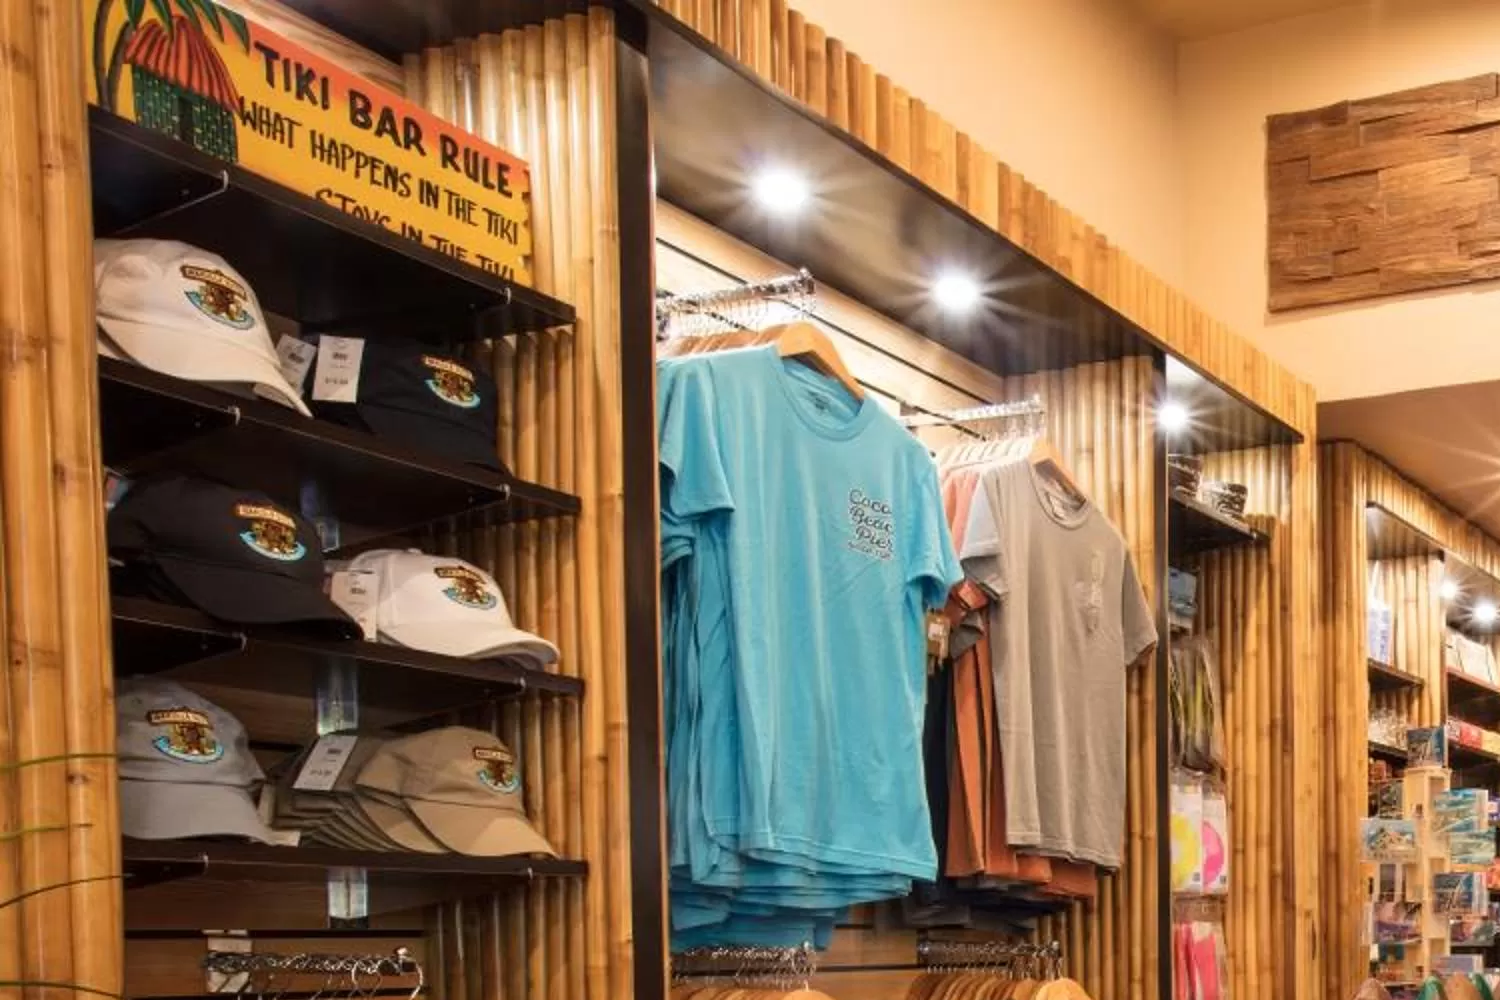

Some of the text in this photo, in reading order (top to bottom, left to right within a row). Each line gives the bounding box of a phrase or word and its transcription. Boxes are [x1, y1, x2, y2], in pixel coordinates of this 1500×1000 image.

[254, 40, 330, 111] TIKI
[348, 88, 427, 158] BAR
[439, 133, 514, 199] RULE
[239, 96, 519, 245] WHAT HAPPENS IN THE TIKI
[849, 489, 892, 515] Coco
[849, 506, 893, 532] Beac
